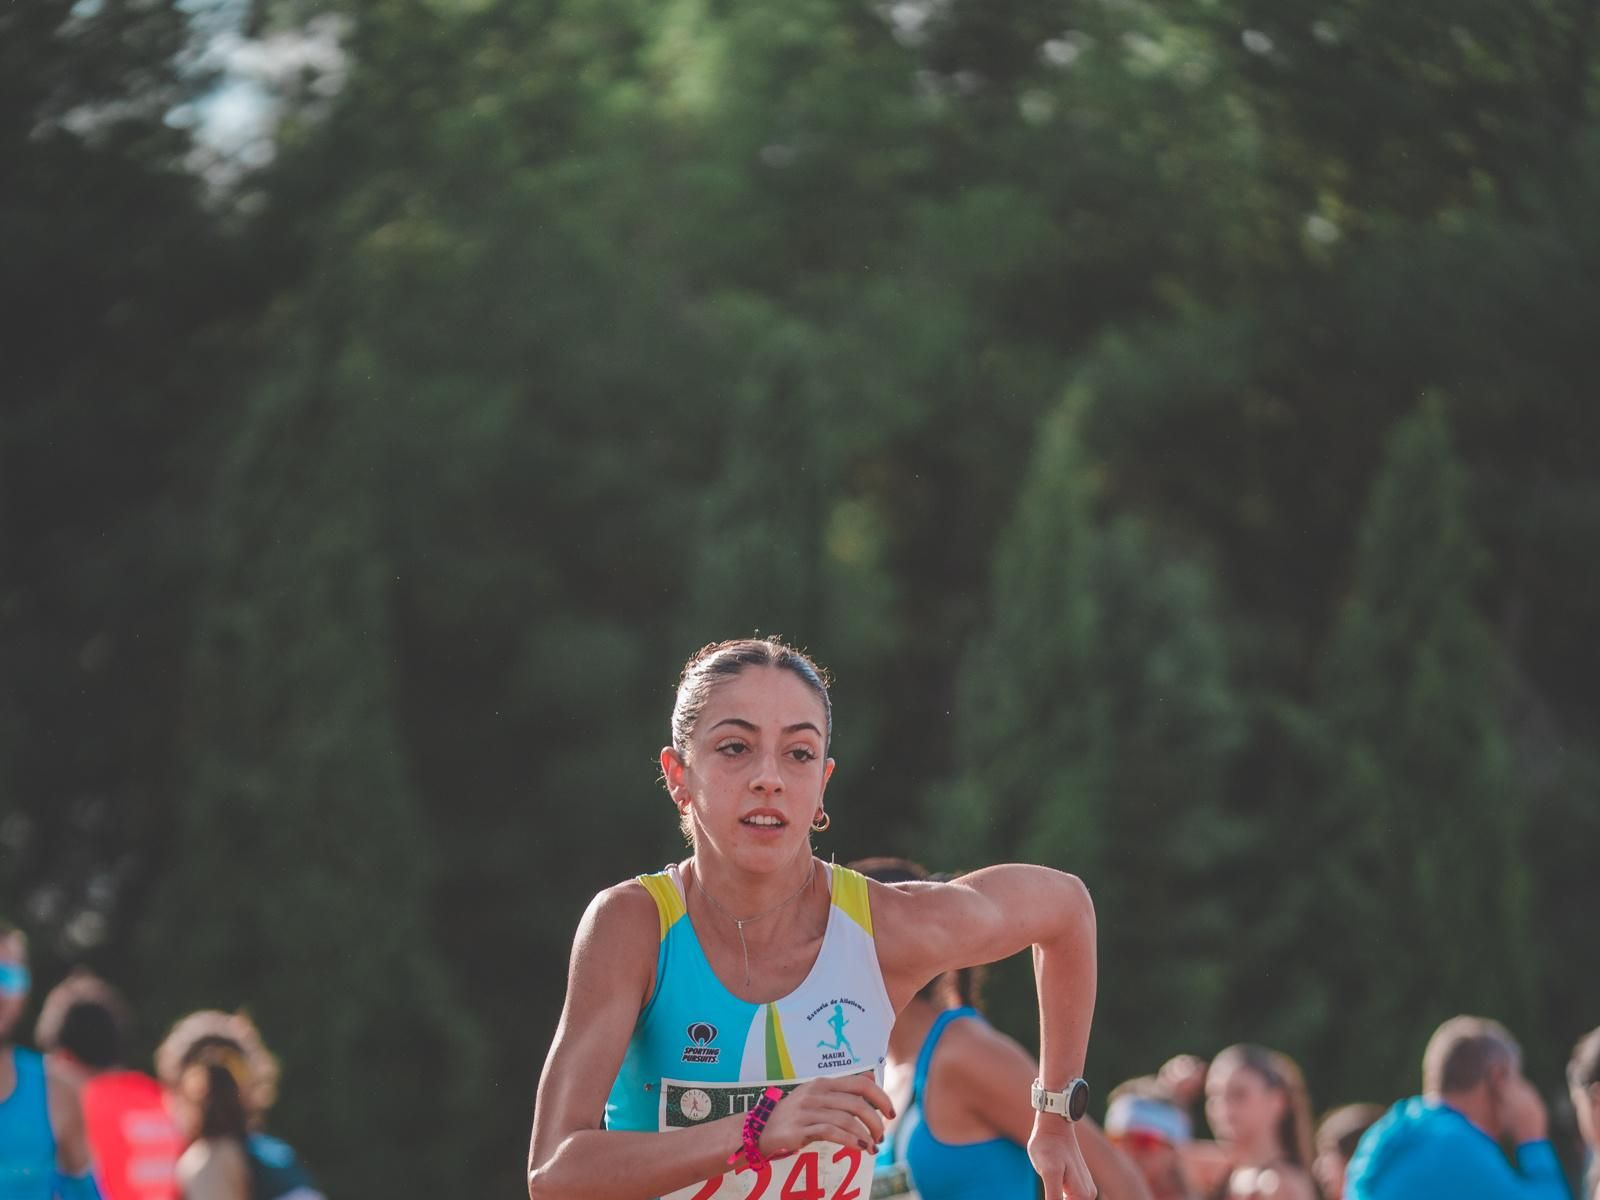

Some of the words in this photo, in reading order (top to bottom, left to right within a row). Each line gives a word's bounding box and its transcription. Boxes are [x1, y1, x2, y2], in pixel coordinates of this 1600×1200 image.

[684, 1047, 720, 1056] SPORTING
[822, 1051, 845, 1060] MAURI
[817, 1059, 852, 1069] CASTILLO
